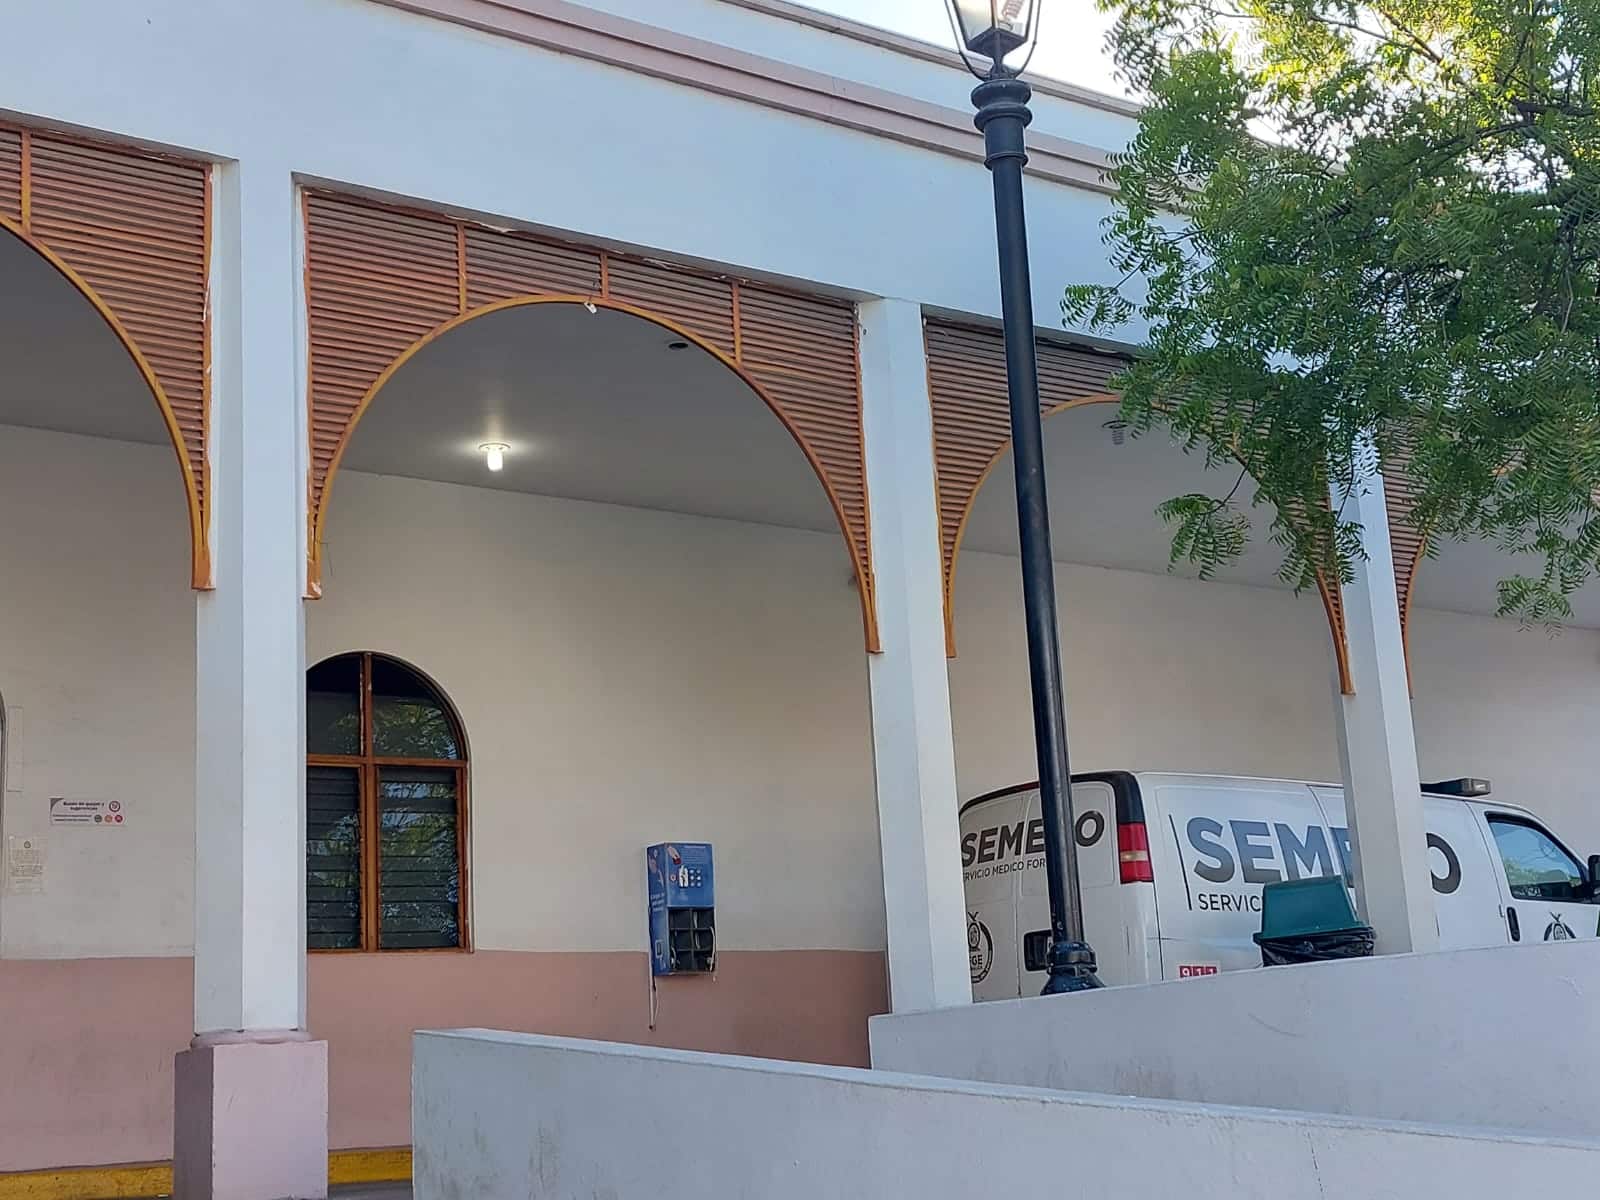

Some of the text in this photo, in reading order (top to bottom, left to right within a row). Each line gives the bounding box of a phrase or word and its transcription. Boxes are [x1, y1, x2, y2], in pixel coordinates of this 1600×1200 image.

[961, 810, 1105, 867] SEMEO
[992, 861, 1024, 876] MEDICO
[1198, 893, 1263, 912] SERVIC
